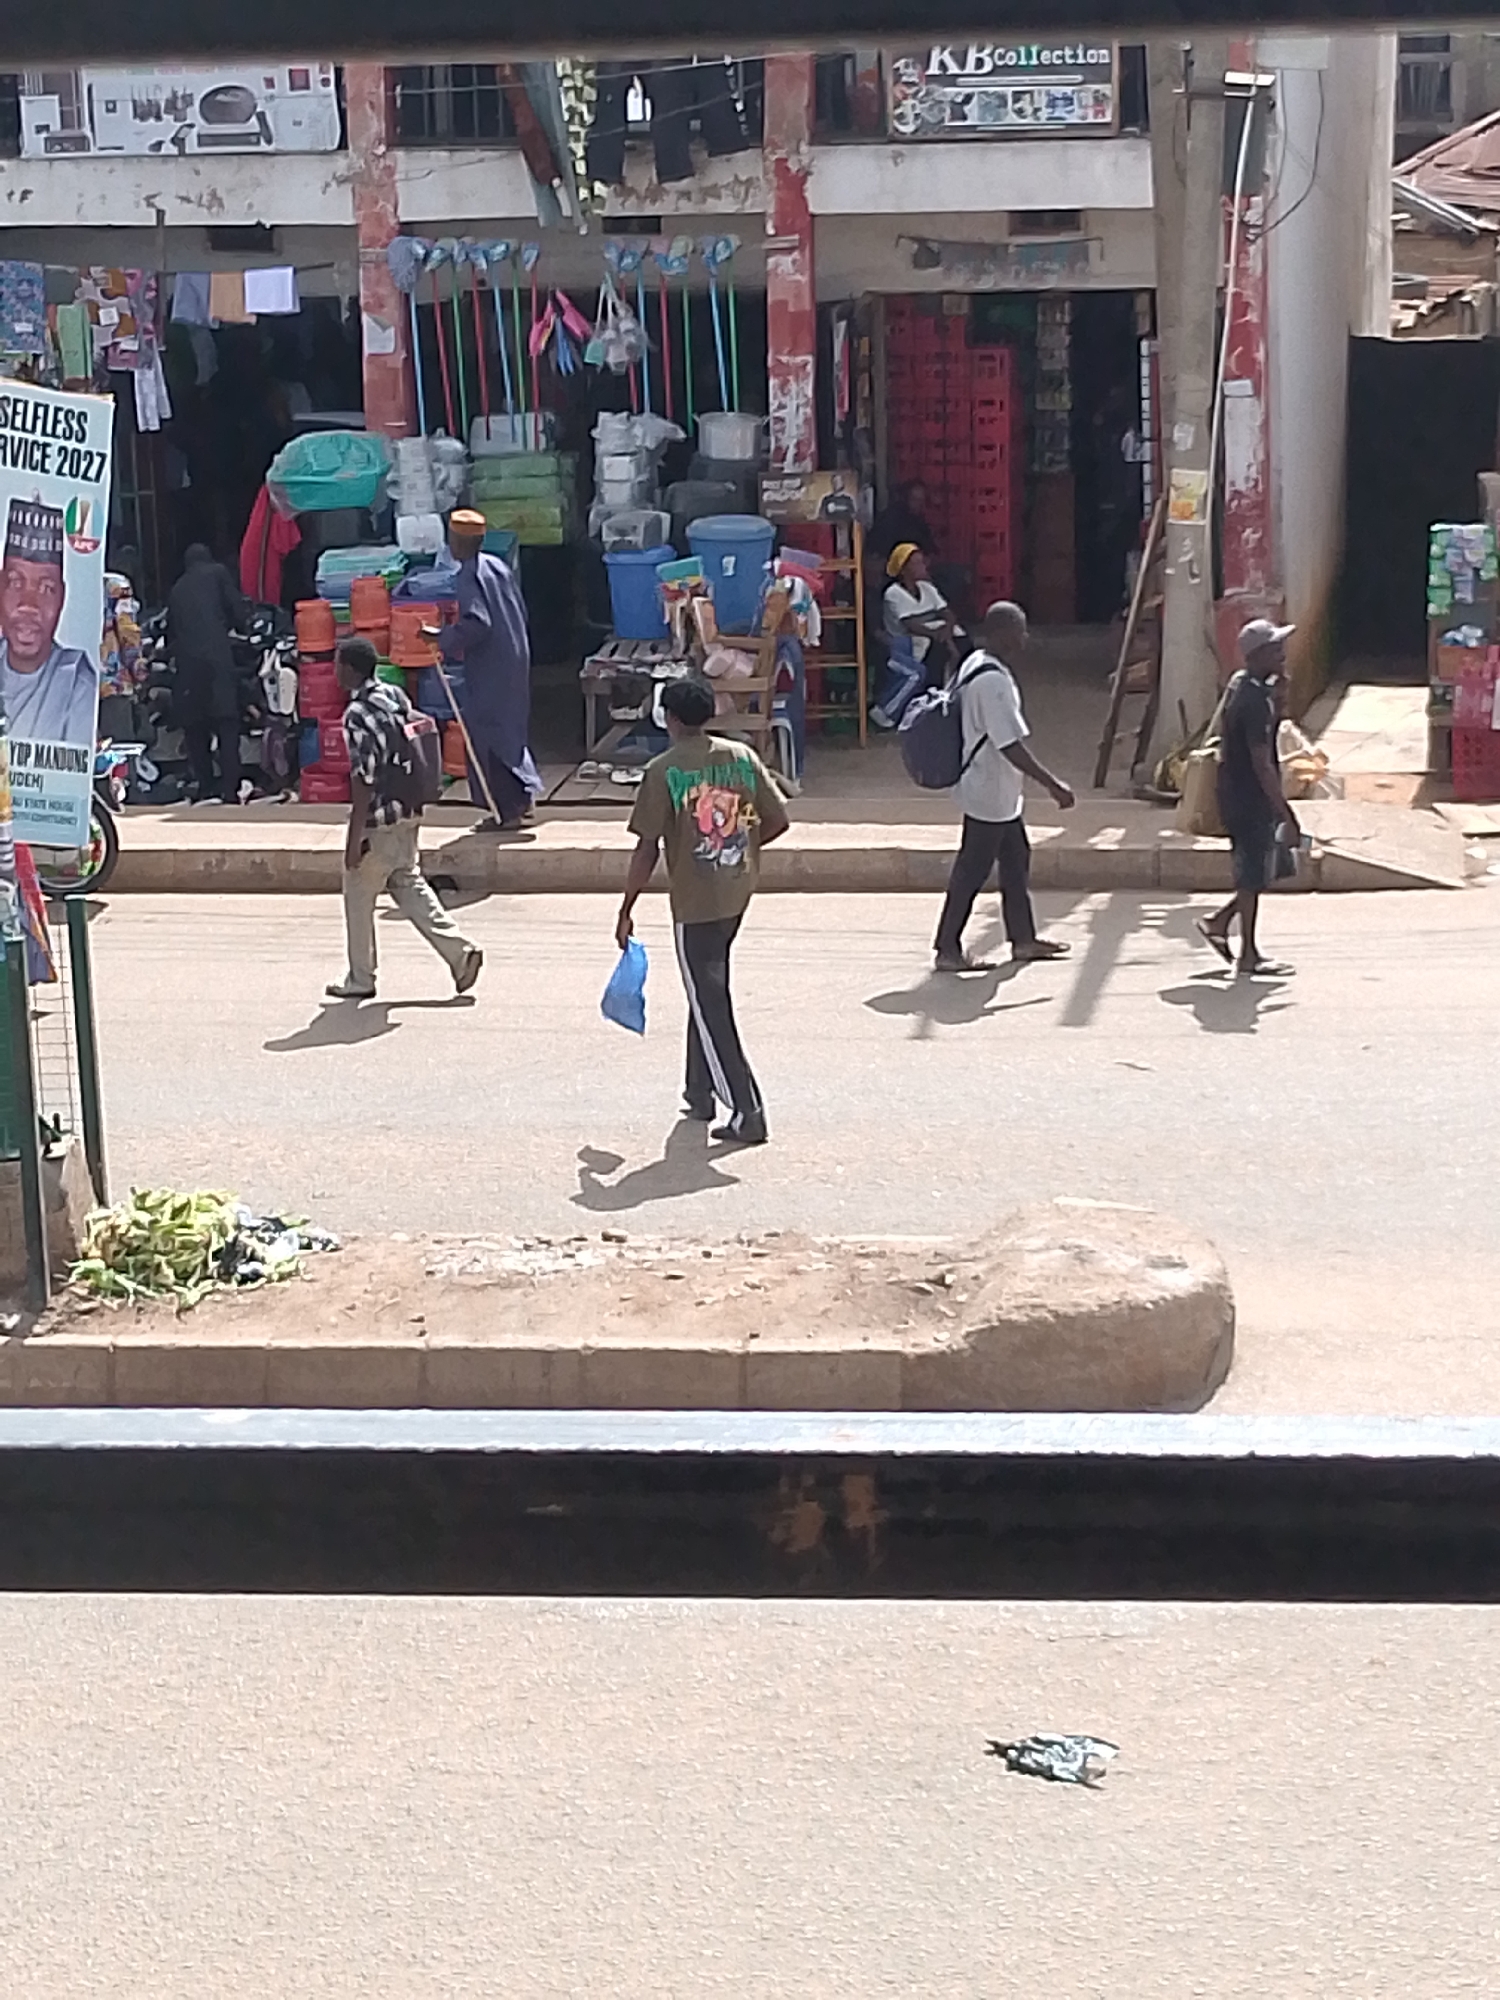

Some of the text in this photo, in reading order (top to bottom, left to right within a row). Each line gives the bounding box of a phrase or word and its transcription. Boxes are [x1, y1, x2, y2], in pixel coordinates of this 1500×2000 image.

[924, 43, 1111, 76] KB Collection
[0, 395, 88, 444] SELFLESS
[55, 445, 107, 483] 2027
